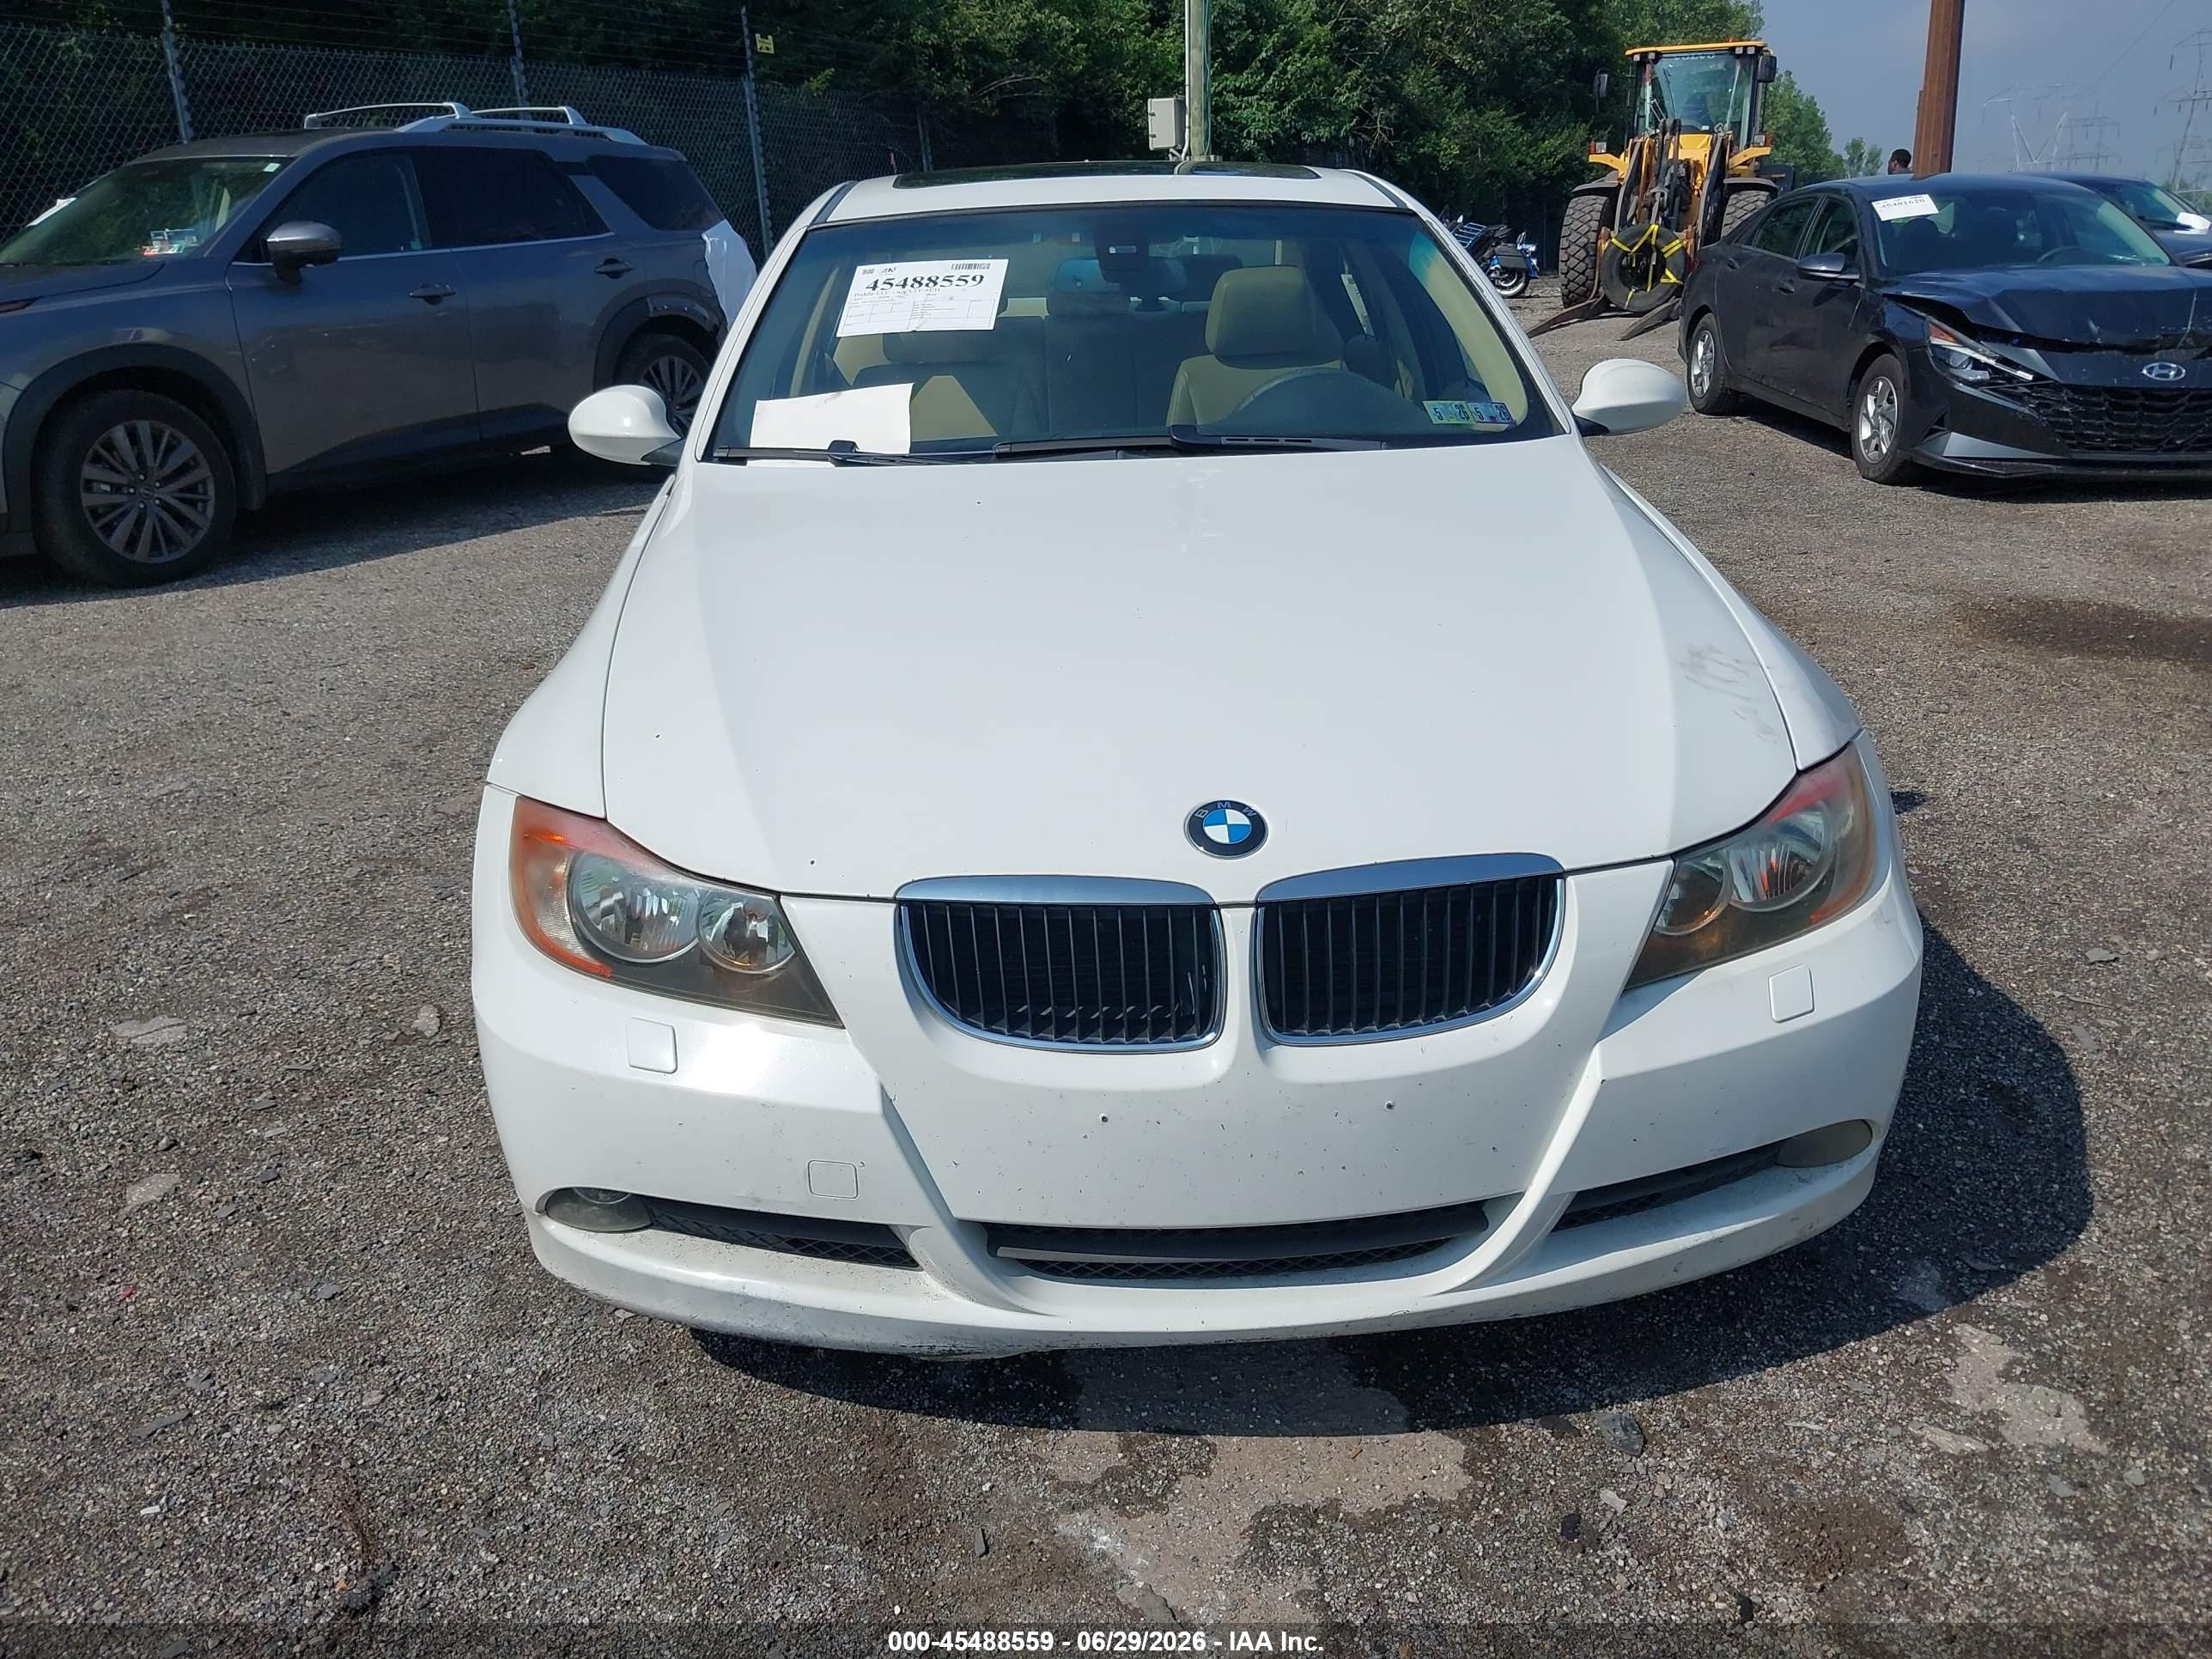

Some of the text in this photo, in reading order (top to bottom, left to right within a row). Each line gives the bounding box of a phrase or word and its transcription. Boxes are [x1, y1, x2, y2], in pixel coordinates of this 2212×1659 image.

[866, 274, 985, 291] 45488559
[1432, 404, 1470, 421] 5 26
[1474, 407, 1485, 421] 5
[1194, 801, 1257, 818] BMW
